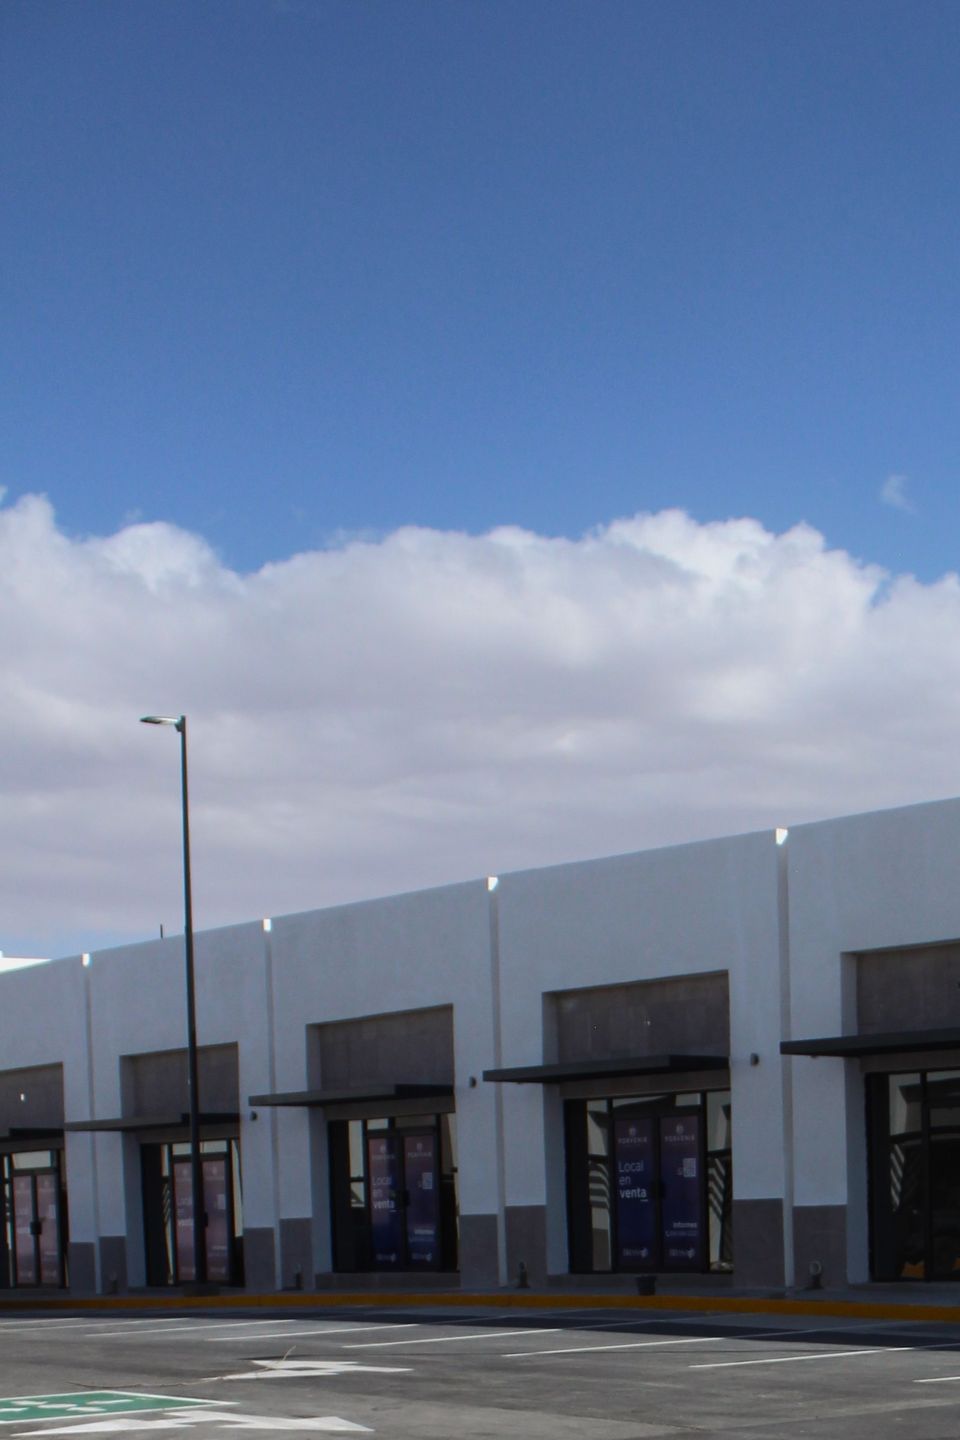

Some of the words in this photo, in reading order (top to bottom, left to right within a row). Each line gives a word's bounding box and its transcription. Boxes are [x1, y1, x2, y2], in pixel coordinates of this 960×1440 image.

[618, 1160, 644, 1172] Local
[619, 1176, 631, 1186] en
[620, 1187, 647, 1199] venta
